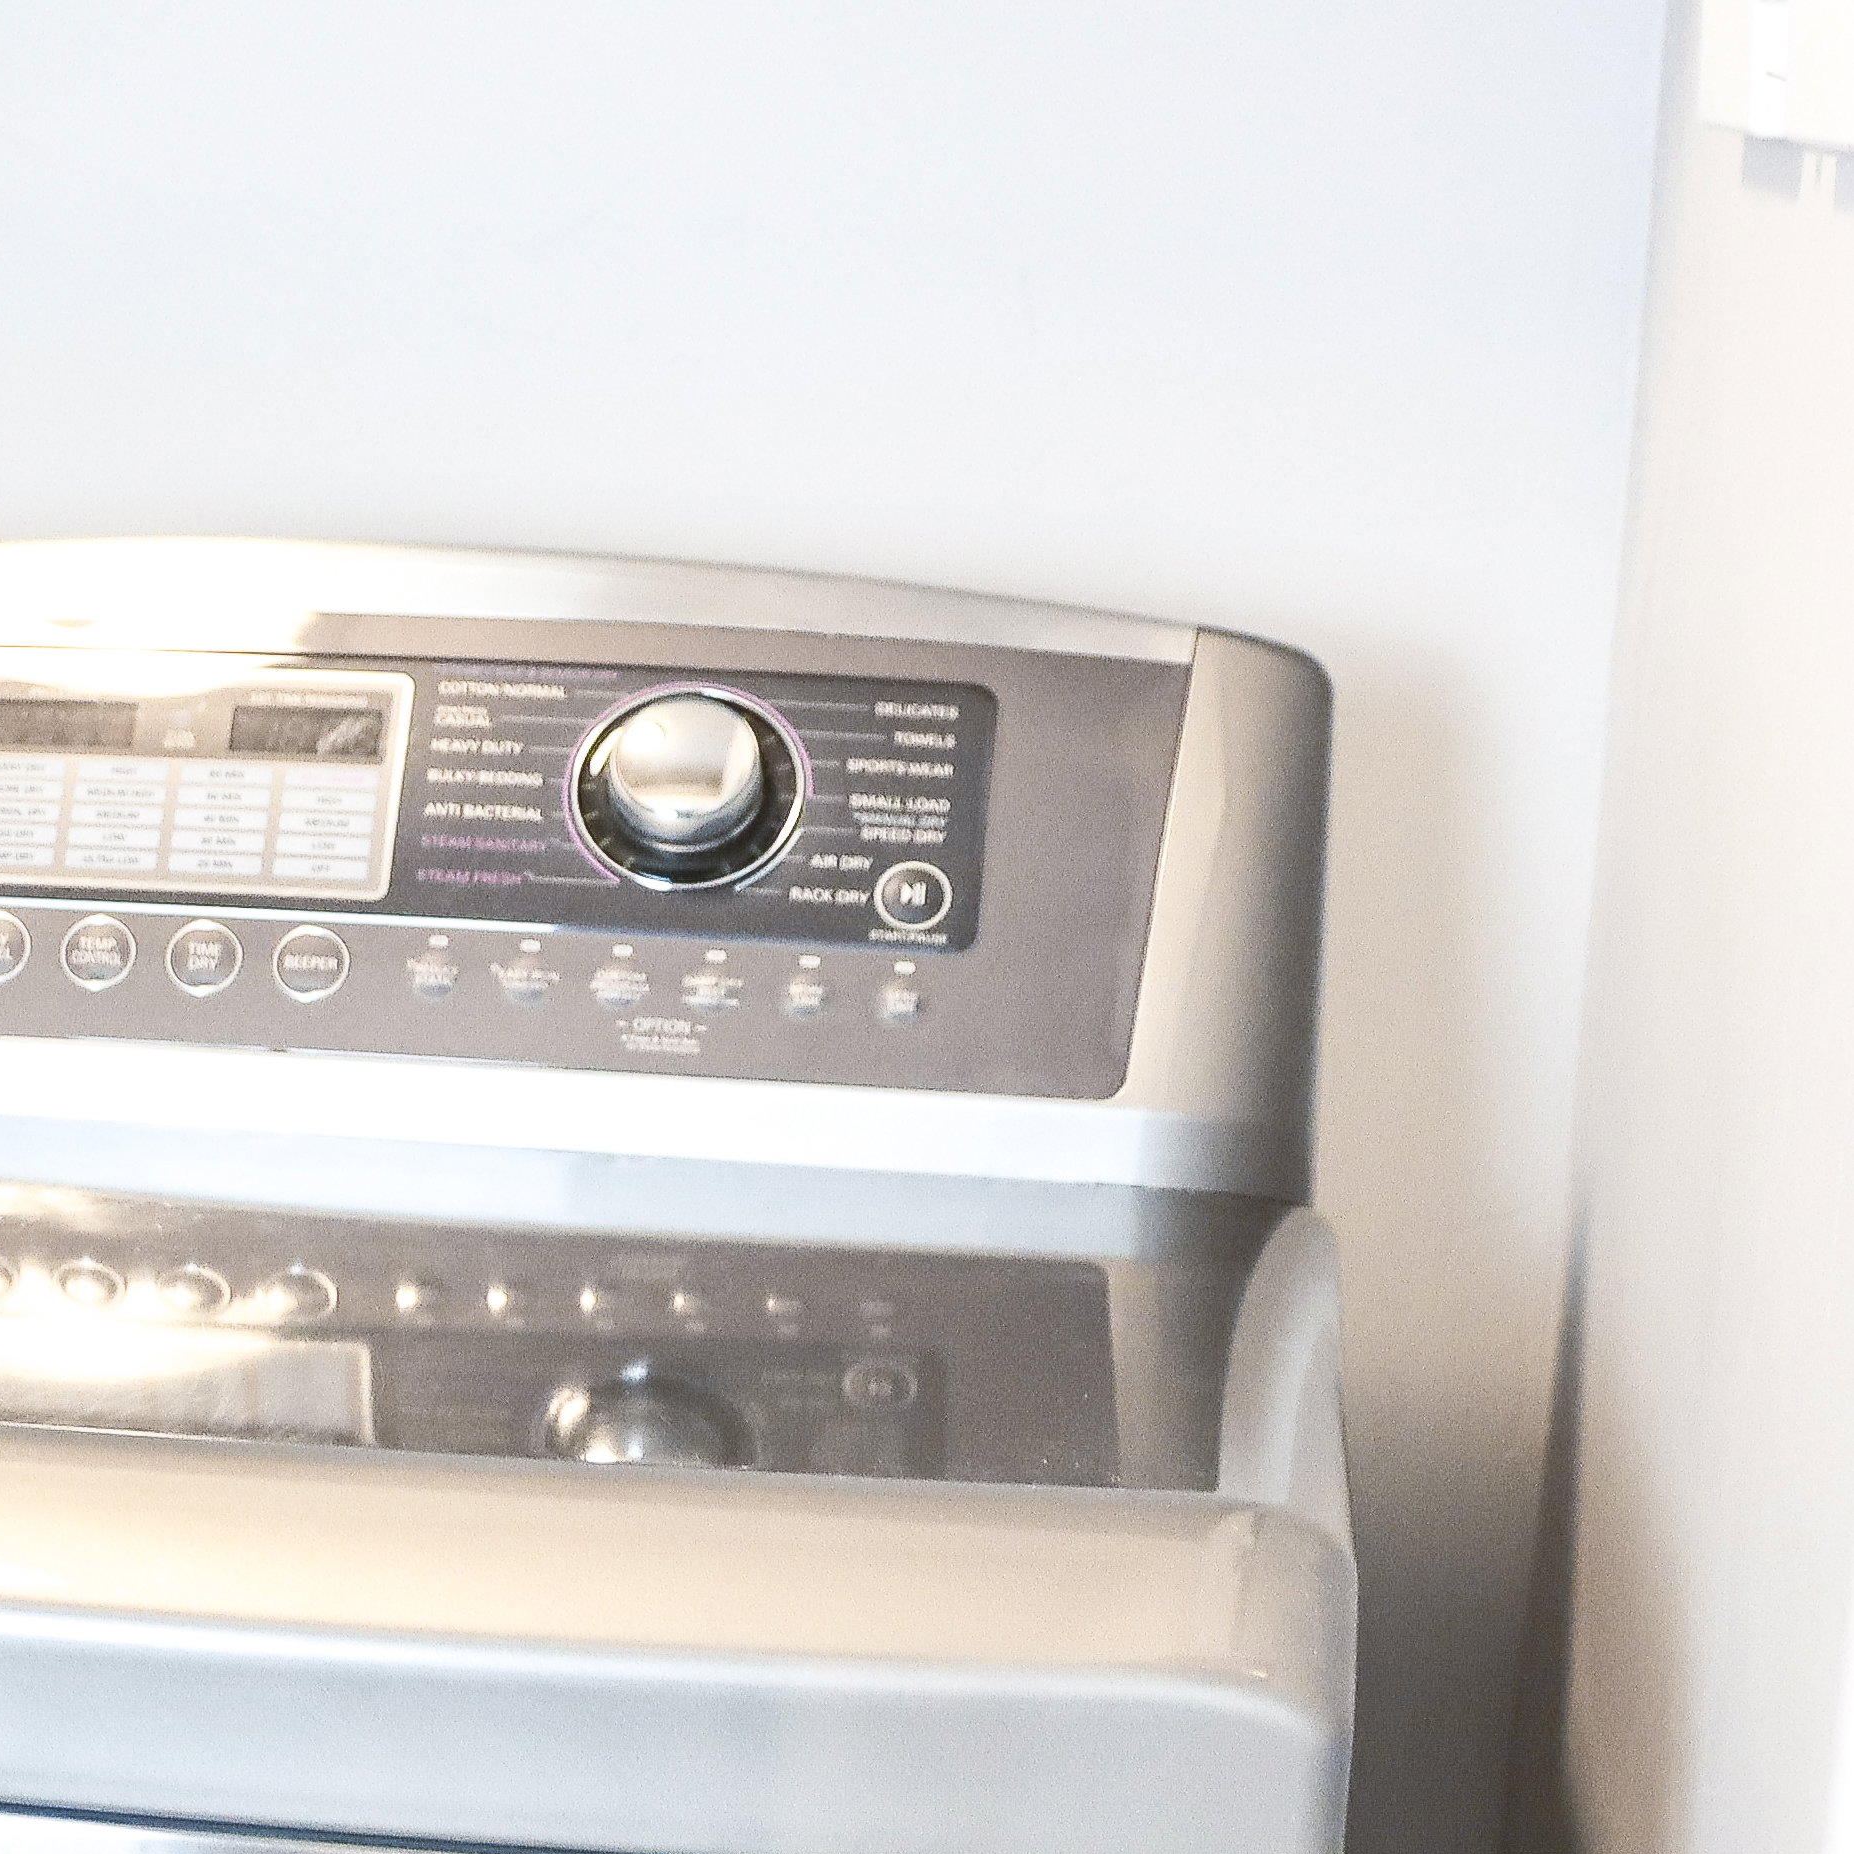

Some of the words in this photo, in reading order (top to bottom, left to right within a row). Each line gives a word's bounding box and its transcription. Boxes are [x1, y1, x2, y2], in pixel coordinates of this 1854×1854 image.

[874, 701, 960, 720] DELICATES
[430, 738, 481, 754] HEAVY
[482, 740, 524, 755] DUTY
[894, 730, 957, 749] TOWELS
[849, 793, 903, 811] SMALL
[907, 797, 951, 814] LOAD
[424, 803, 461, 817] ANTI
[463, 804, 543, 822] BACTERIAL
[860, 826, 912, 842] SPEED
[914, 828, 948, 843] DRY
[809, 854, 838, 869] AIR
[840, 855, 873, 871] DRY
[788, 886, 834, 902] RACK
[836, 888, 870, 904] DRY
[70, 949, 122, 966] CONTROL
[188, 942, 222, 957] TIME
[187, 956, 218, 971] DRY
[283, 954, 338, 971] BEEPER
[633, 1017, 692, 1034] OPTION
